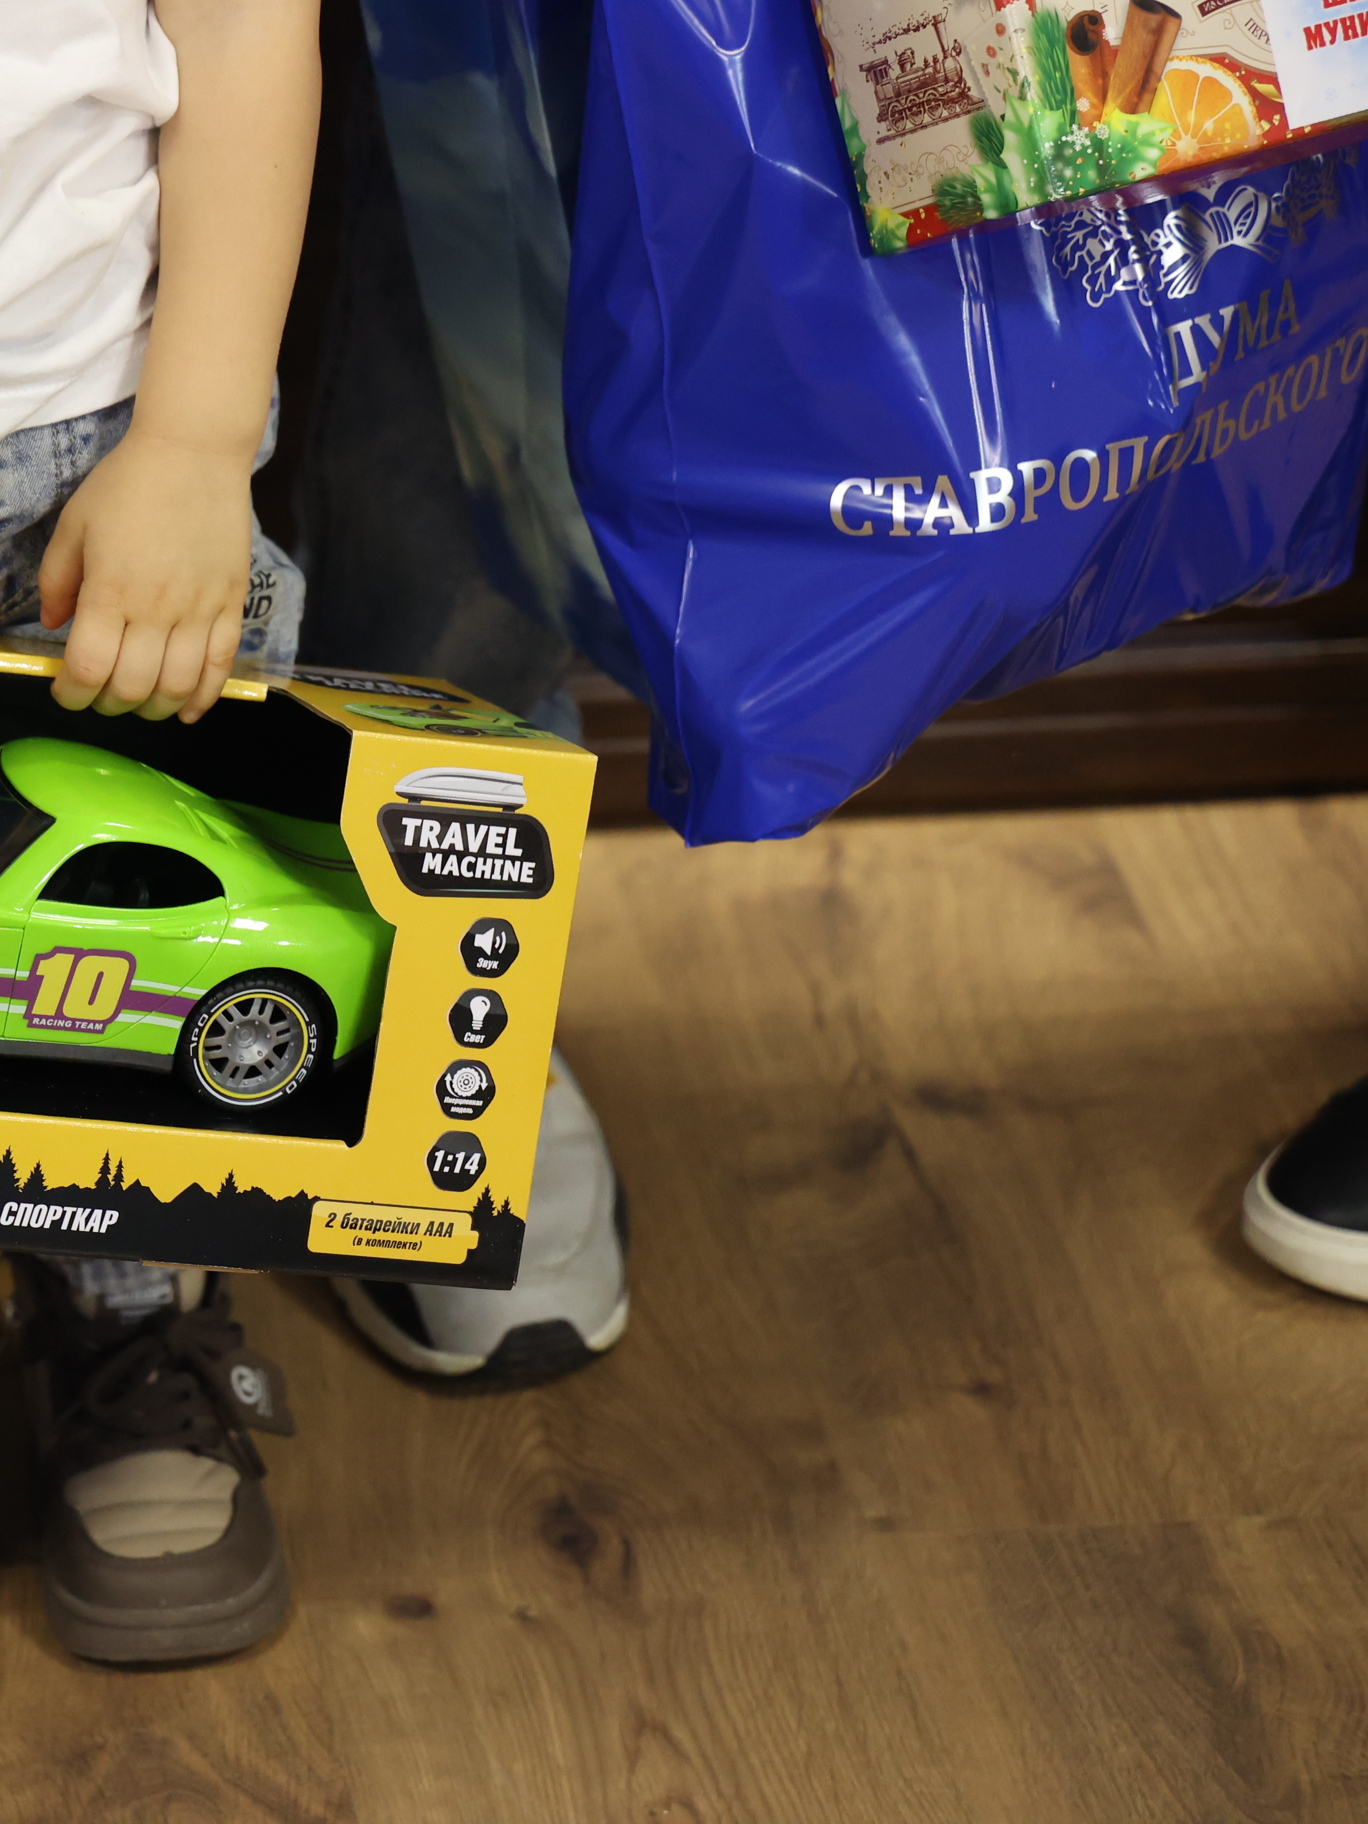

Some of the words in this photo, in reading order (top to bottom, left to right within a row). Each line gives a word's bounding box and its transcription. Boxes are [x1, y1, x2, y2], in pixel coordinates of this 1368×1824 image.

[1165, 278, 1301, 407] ДУМА
[830, 327, 1368, 537] СТАВРОПОЛЬСКОГО
[401, 817, 524, 857] TRAVEL
[421, 852, 536, 883] MACHINE
[476, 957, 499, 970] Звук
[31, 953, 130, 1020] 10
[32, 1017, 73, 1028] RACING
[75, 1021, 103, 1031] TEAM
[463, 1031, 486, 1043] Свет
[433, 1149, 481, 1176] 1:14
[0, 1201, 120, 1234] СПОРТКАР
[325, 1212, 337, 1228] 2
[340, 1212, 421, 1235] батарейки
[352, 1235, 363, 1247] (в
[365, 1236, 422, 1252] комплекте)
